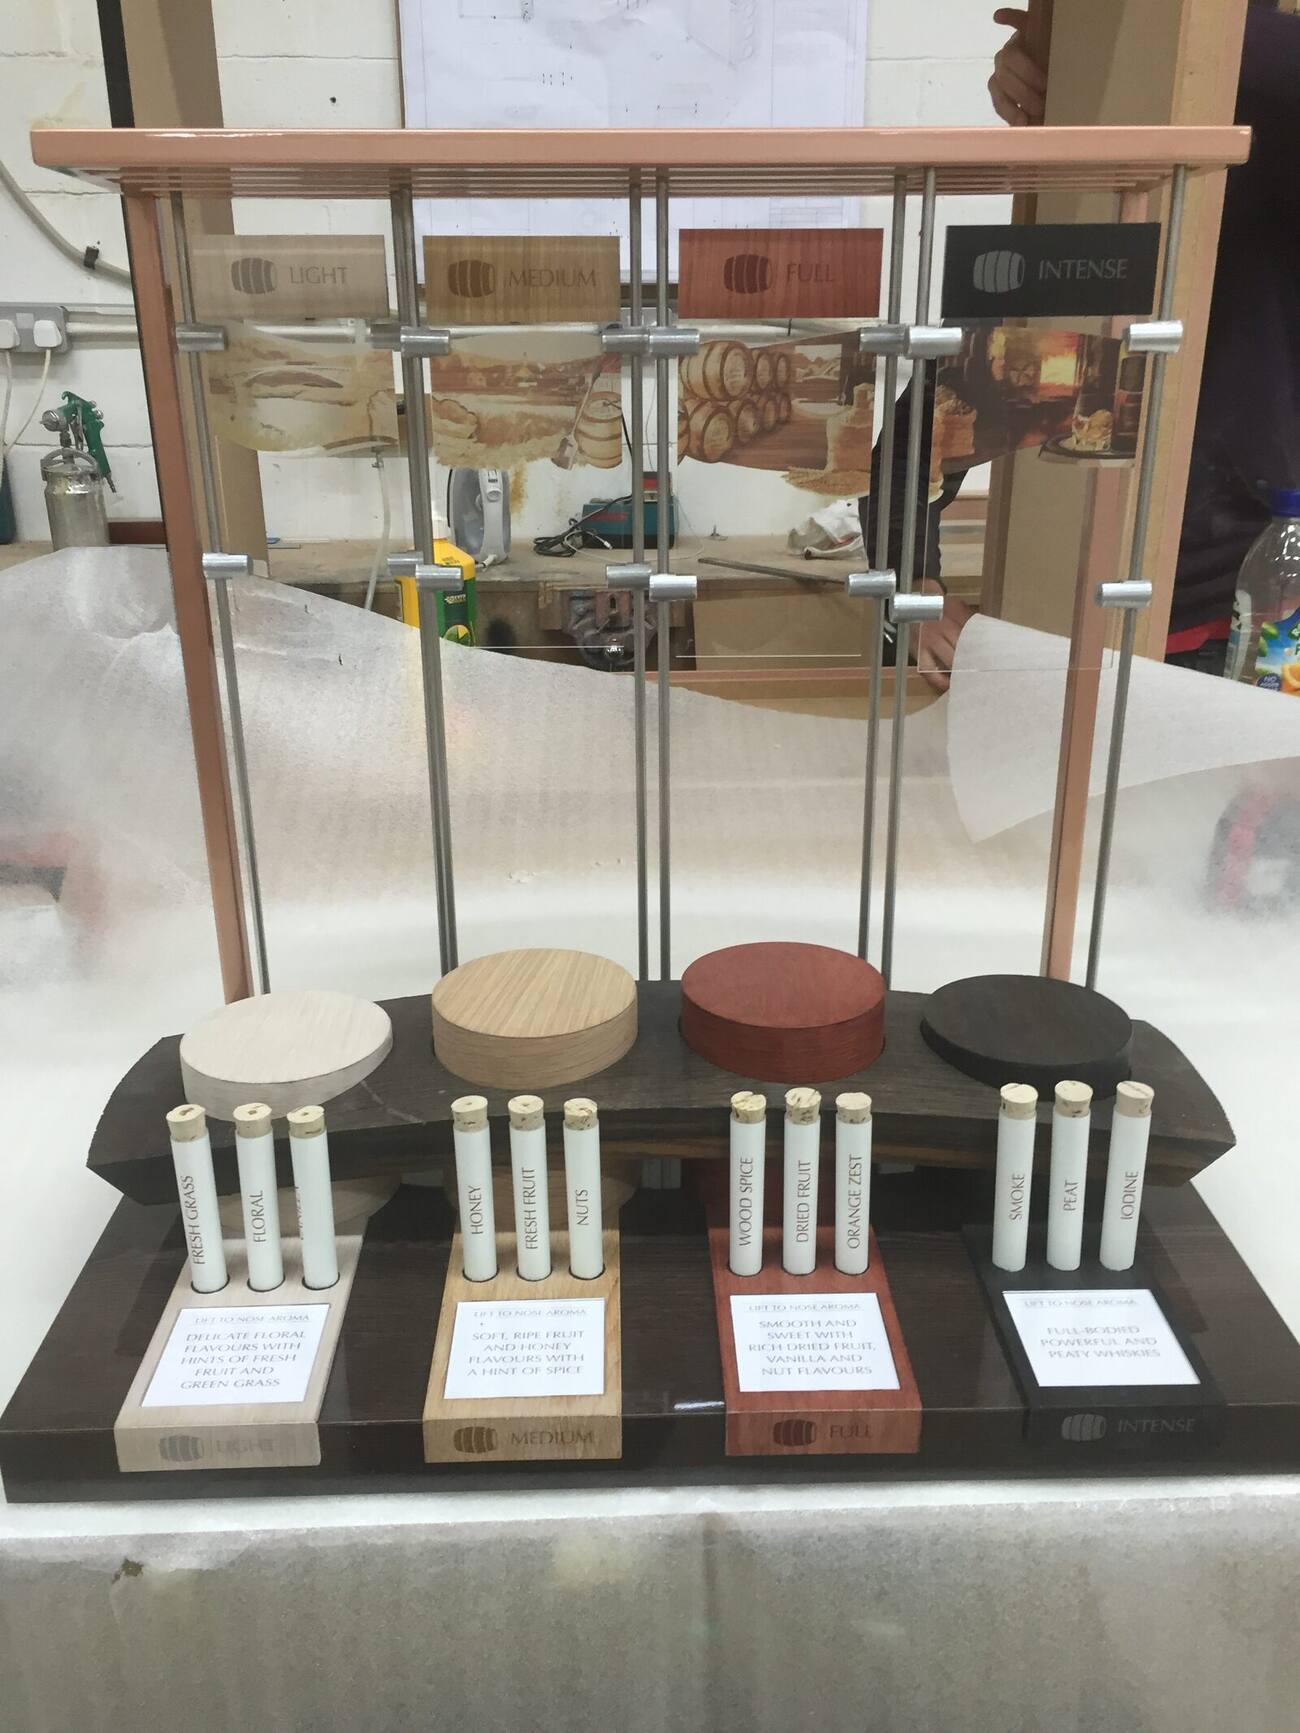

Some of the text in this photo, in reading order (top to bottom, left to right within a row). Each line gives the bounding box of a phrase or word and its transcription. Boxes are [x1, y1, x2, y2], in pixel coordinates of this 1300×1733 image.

[289, 266, 349, 285] LIGHT
[786, 263, 836, 284] FULL
[1038, 258, 1129, 281] INTENSE
[507, 268, 597, 288] MEDIUM
[738, 1156, 754, 1247] WOOD SPICE
[795, 1160, 811, 1243] DRIED FRUIT
[846, 1154, 863, 1249] ORANGE ZEST
[1009, 1173, 1025, 1221] SMOKE
[1062, 1179, 1079, 1212] PEAT
[1120, 1171, 1139, 1220] IODINE
[468, 1185, 485, 1235] HONEY
[521, 1167, 539, 1250] FRESH FRUIT
[575, 1189, 590, 1226] NUTS
[180, 1175, 206, 1265] FRESH GRASS
[249, 1190, 267, 1243] FLORAL
[758, 1319, 857, 1329] SMOOTH AND
[1047, 1326, 1141, 1335] FULL-BODIED
[186, 1331, 306, 1342] DELICATE FLORAL
[513, 1331, 541, 1340] RIPE
[546, 1330, 585, 1339] FRUIT
[767, 1330, 854, 1340] SWEET WITH
[1040, 1337, 1158, 1347] POWERFUL AND
[184, 1342, 301, 1353] FLAVOURS WITH
[483, 1342, 572, 1352] AND HONEY
[748, 1342, 877, 1352] RICH DRIED FRUIT,
[1049, 1349, 1161, 1359] PEATY WHISKIES
[181, 1354, 297, 1365] HINTS OF FRESH
[468, 1353, 585, 1364] FLAVOURS WITH
[766, 1354, 863, 1364] VANILLA AND
[194, 1366, 274, 1376] FRUIT AND
[466, 1366, 584, 1376] A HINT OF SPICE
[761, 1366, 873, 1376] NUT FLAVOURS
[180, 1379, 280, 1389] GREEN GRASS
[829, 1424, 873, 1440] FULL
[1117, 1418, 1197, 1433] INTENSE
[510, 1429, 595, 1445] MEDIUM
